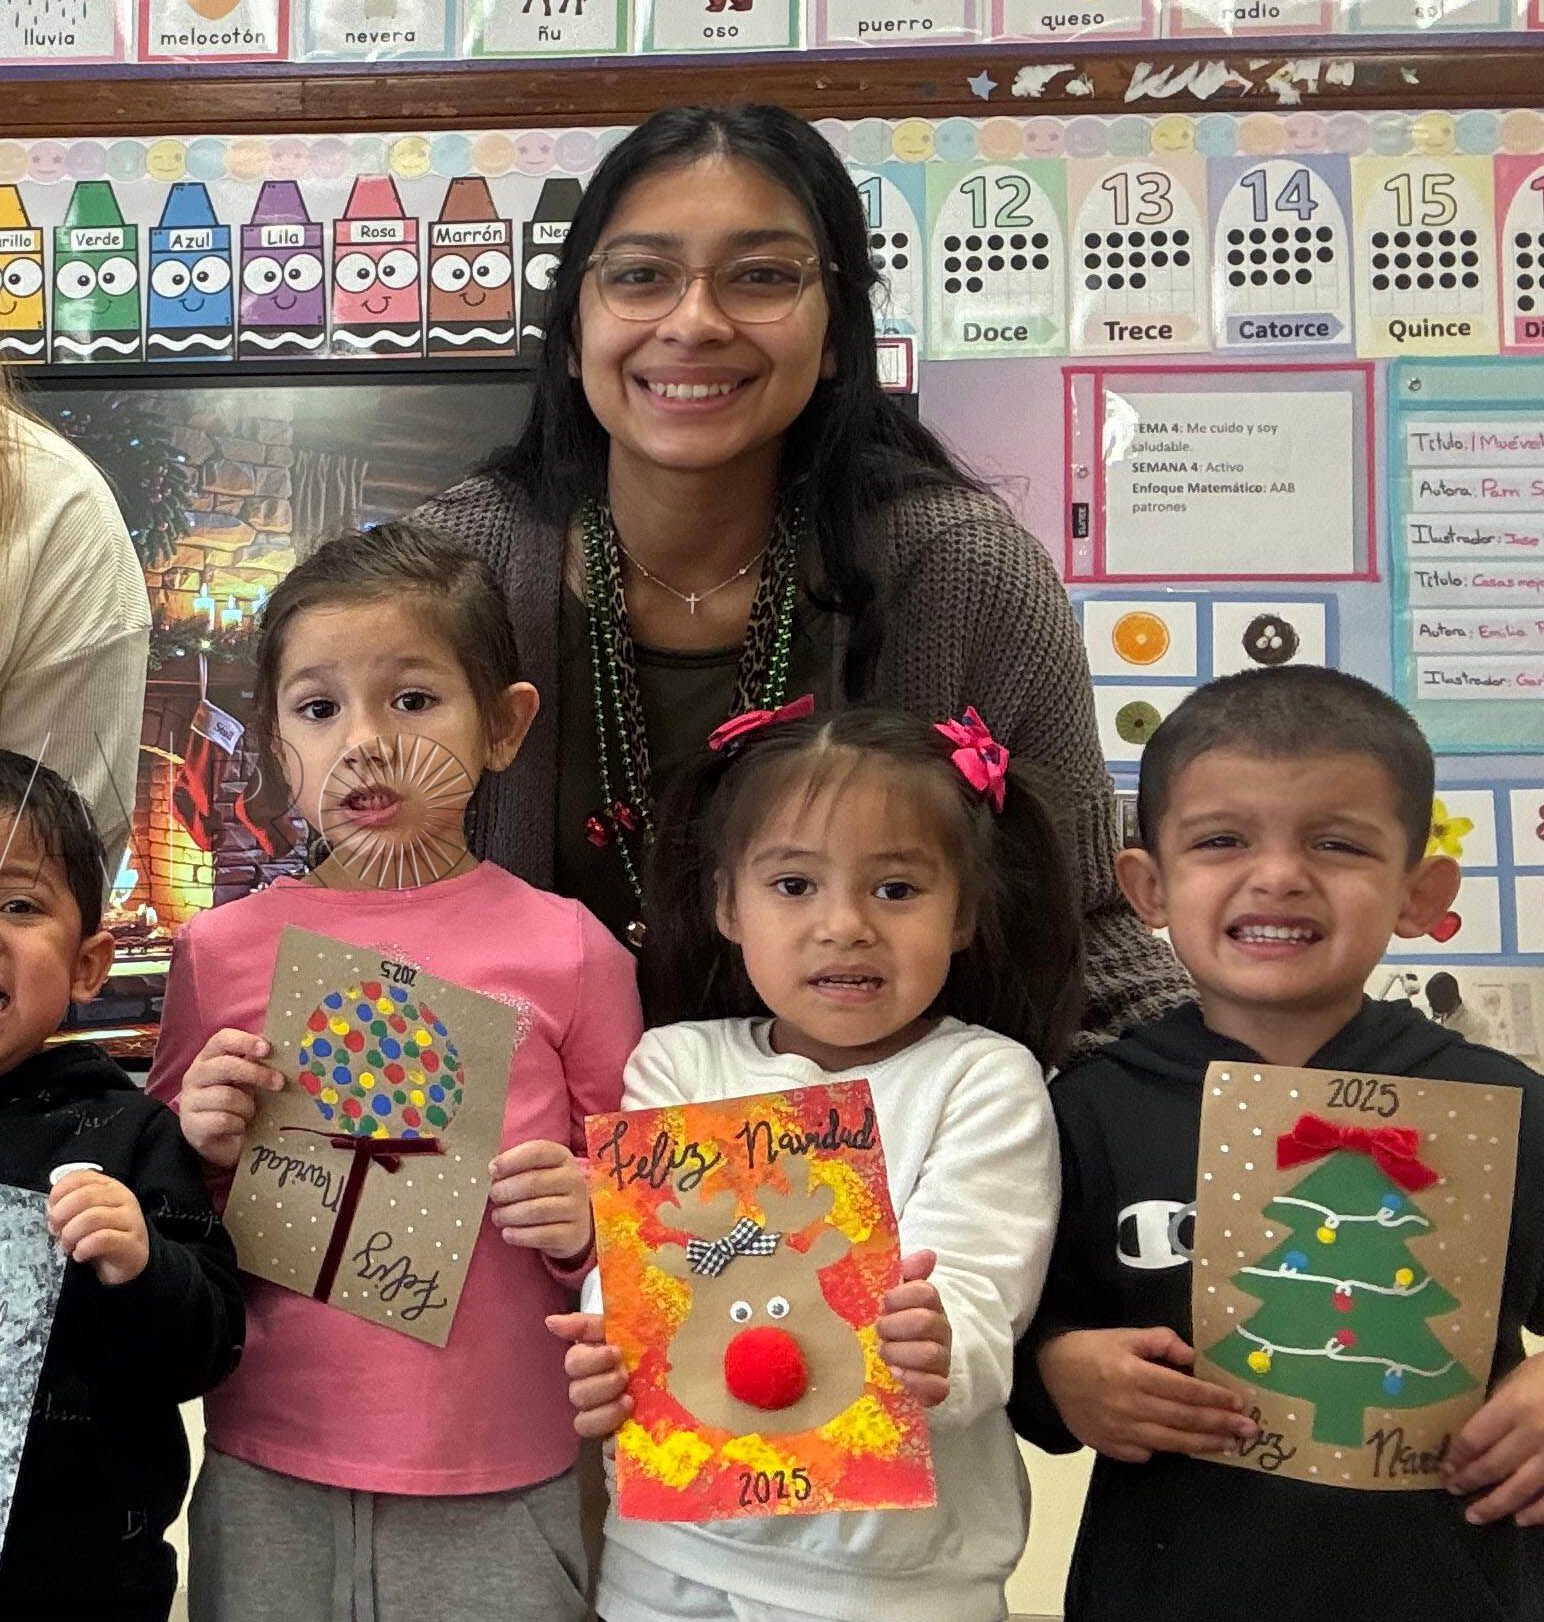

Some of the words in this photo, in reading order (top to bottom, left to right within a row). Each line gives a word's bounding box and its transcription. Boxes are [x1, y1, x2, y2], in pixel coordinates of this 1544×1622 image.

[858, 17, 933, 36] puerro
[1041, 12, 1105, 31] queso
[24, 29, 75, 46] lluvia
[160, 28, 266, 46] melocotón
[345, 30, 416, 44] nevera
[537, 25, 562, 41] ñu
[703, 25, 739, 38] oso
[960, 175, 1034, 228] 12
[1101, 172, 1174, 226] 13
[1241, 169, 1318, 222] 14
[1384, 173, 1458, 226] 15
[74, 230, 121, 247] Verde
[267, 229, 300, 246] Lila
[359, 223, 397, 239] Rosa
[435, 224, 504, 244] Marrón
[171, 232, 211, 250] Azul
[963, 320, 1029, 342] Doce
[1104, 319, 1174, 341] Trece
[1238, 318, 1330, 340] Catorce
[1388, 318, 1472, 342] Quince
[1186, 422, 1208, 434] Me
[1209, 422, 1244, 434] cuido
[1246, 424, 1255, 436] y
[1257, 424, 1279, 436] soy
[1132, 462, 1188, 474] SEMANA
[1205, 461, 1244, 474] Activo
[1132, 482, 1185, 497] Enfoque
[1270, 482, 1296, 495] AAB
[1481, 478, 1521, 498] Pam
[1132, 501, 1188, 515] patrones
[1326, 1077, 1401, 1118] 2025
[597, 1119, 721, 1193] Feliz
[735, 1106, 877, 1169] Navidad
[352, 1230, 448, 1321] Feliz
